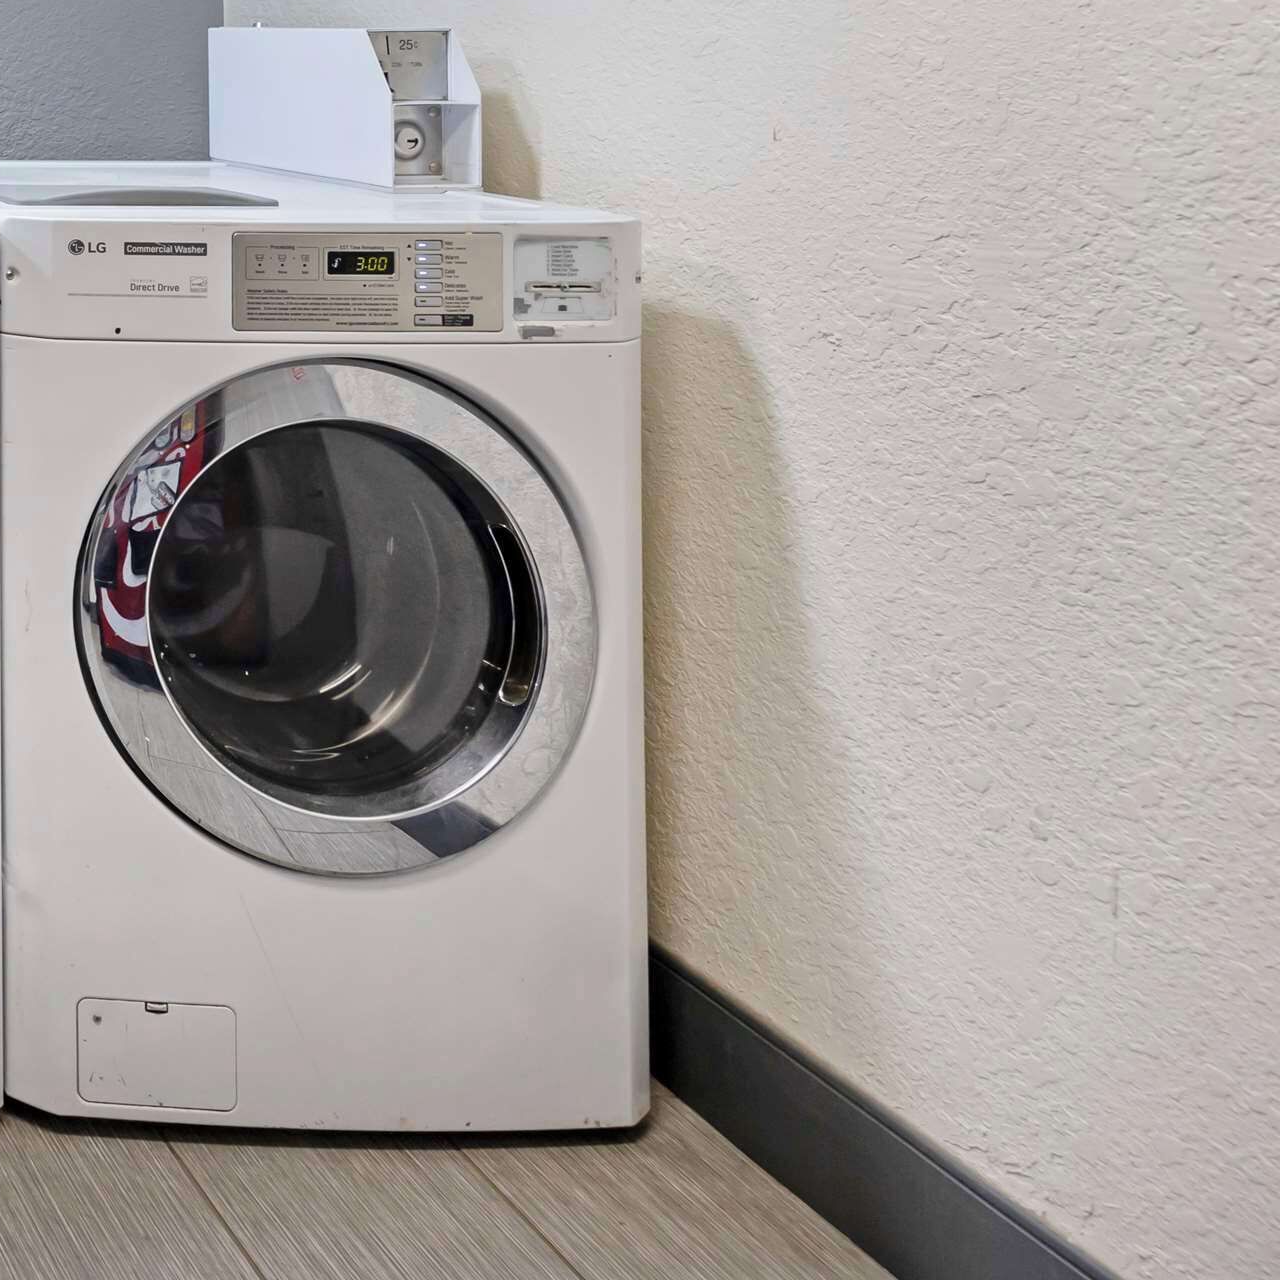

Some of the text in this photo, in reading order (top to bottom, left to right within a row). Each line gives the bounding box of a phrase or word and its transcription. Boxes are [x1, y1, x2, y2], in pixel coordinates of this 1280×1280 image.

[88, 242, 107, 253] LG
[126, 244, 205, 254] Commercial Washer
[130, 283, 180, 292] Direct Drive
